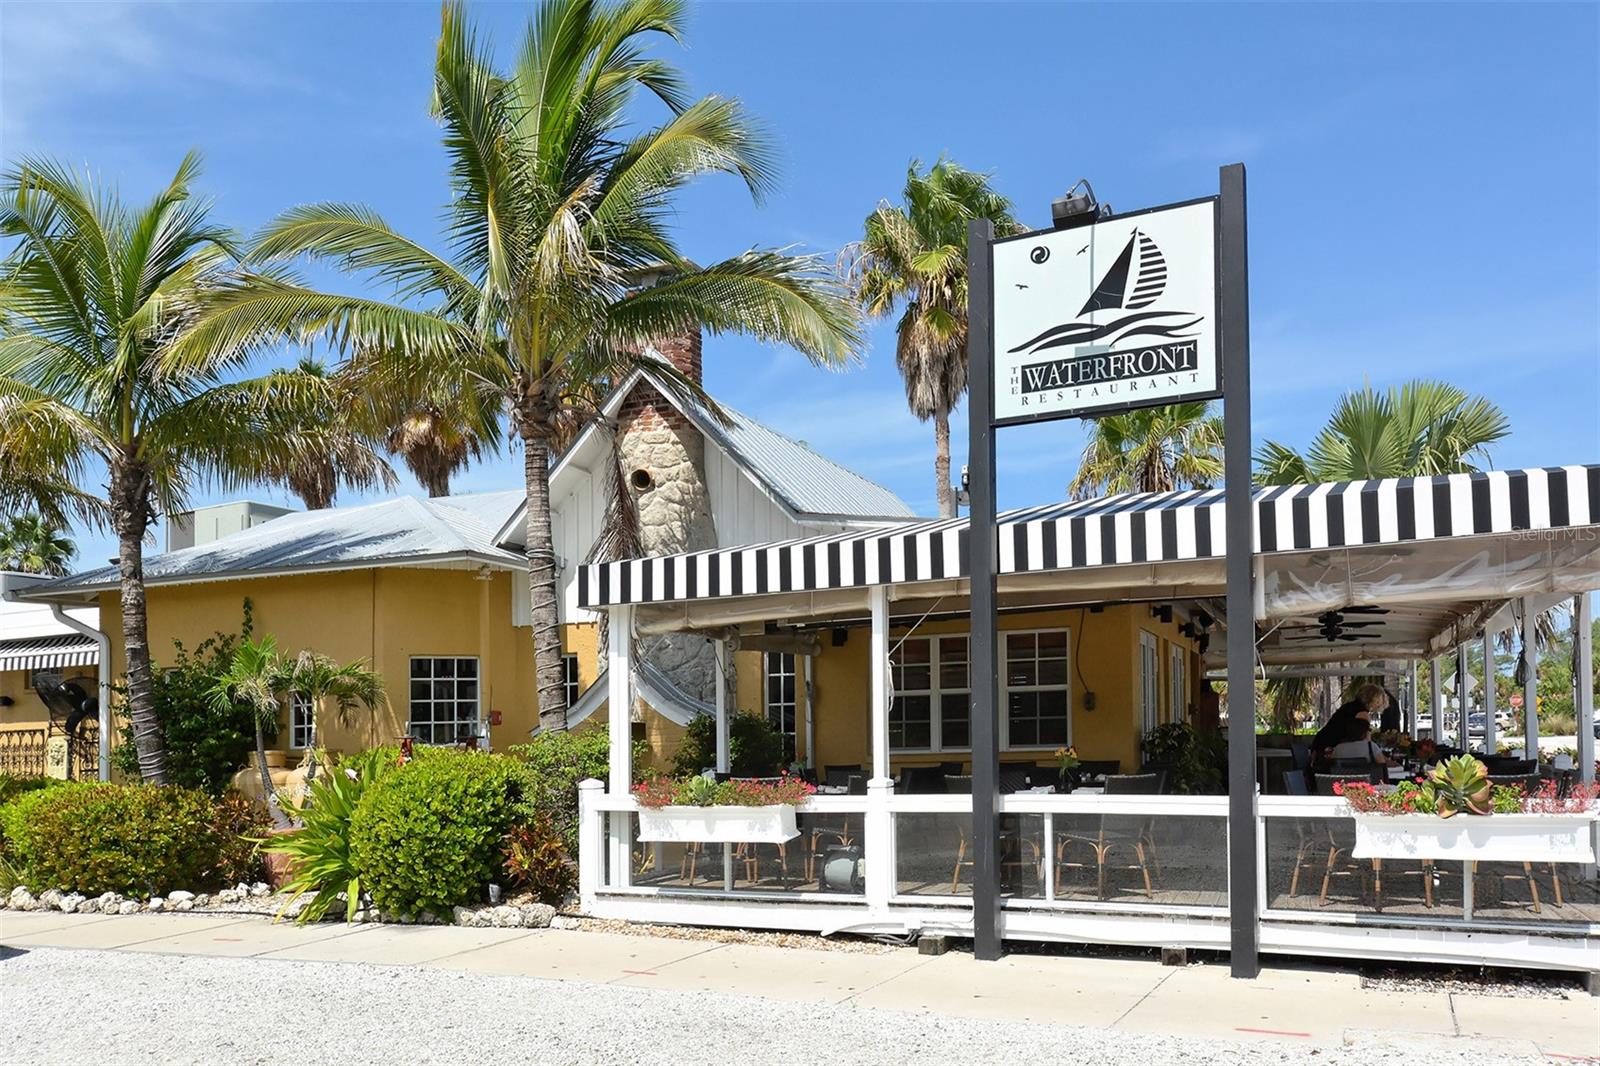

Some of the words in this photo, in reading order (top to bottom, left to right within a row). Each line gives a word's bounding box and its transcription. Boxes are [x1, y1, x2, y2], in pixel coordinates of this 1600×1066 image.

[1010, 366, 1019, 395] THE
[1025, 343, 1195, 391] WATERFRONT
[1021, 372, 1199, 406] RESTAURANT
